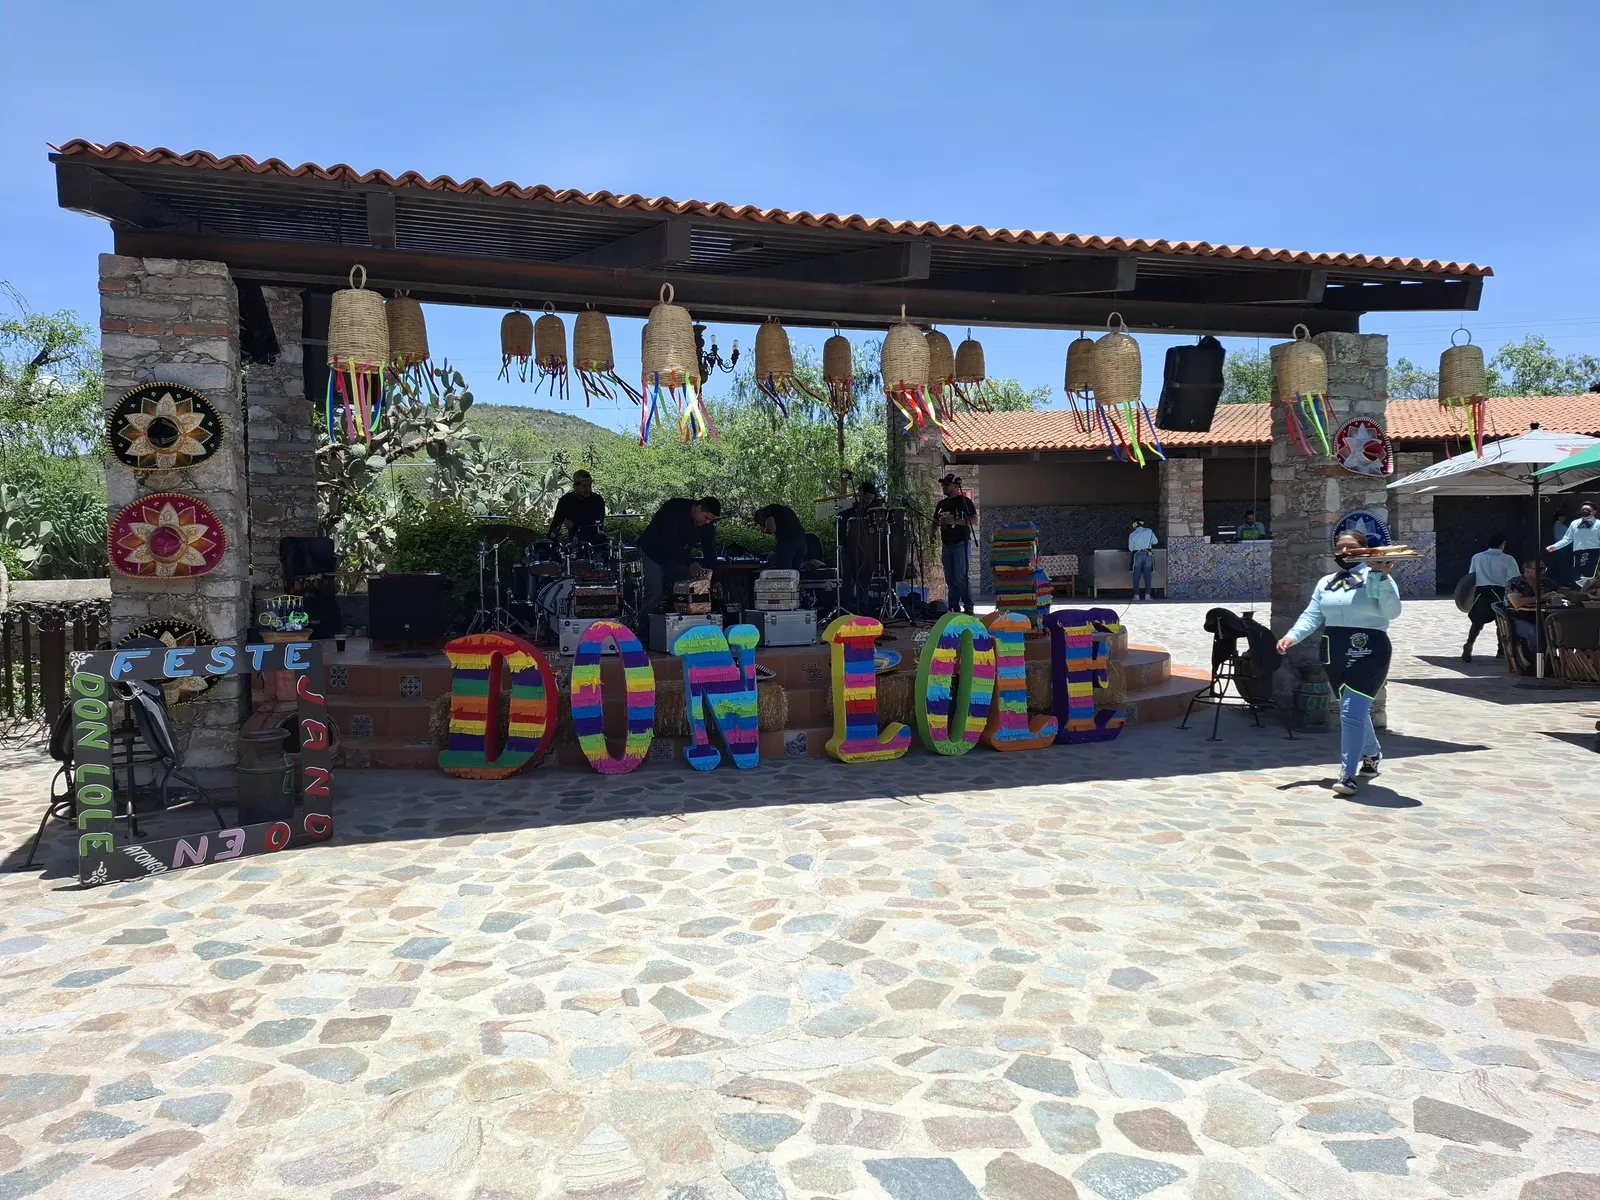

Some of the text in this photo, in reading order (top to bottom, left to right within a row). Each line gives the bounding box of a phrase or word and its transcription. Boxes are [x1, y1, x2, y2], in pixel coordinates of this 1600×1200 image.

[110, 643, 312, 680] FESTE
[437, 608, 1125, 780] DON LOLE
[72, 672, 114, 857] DON LOLE
[122, 845, 168, 875] ATONGO
[172, 828, 246, 869] EN
